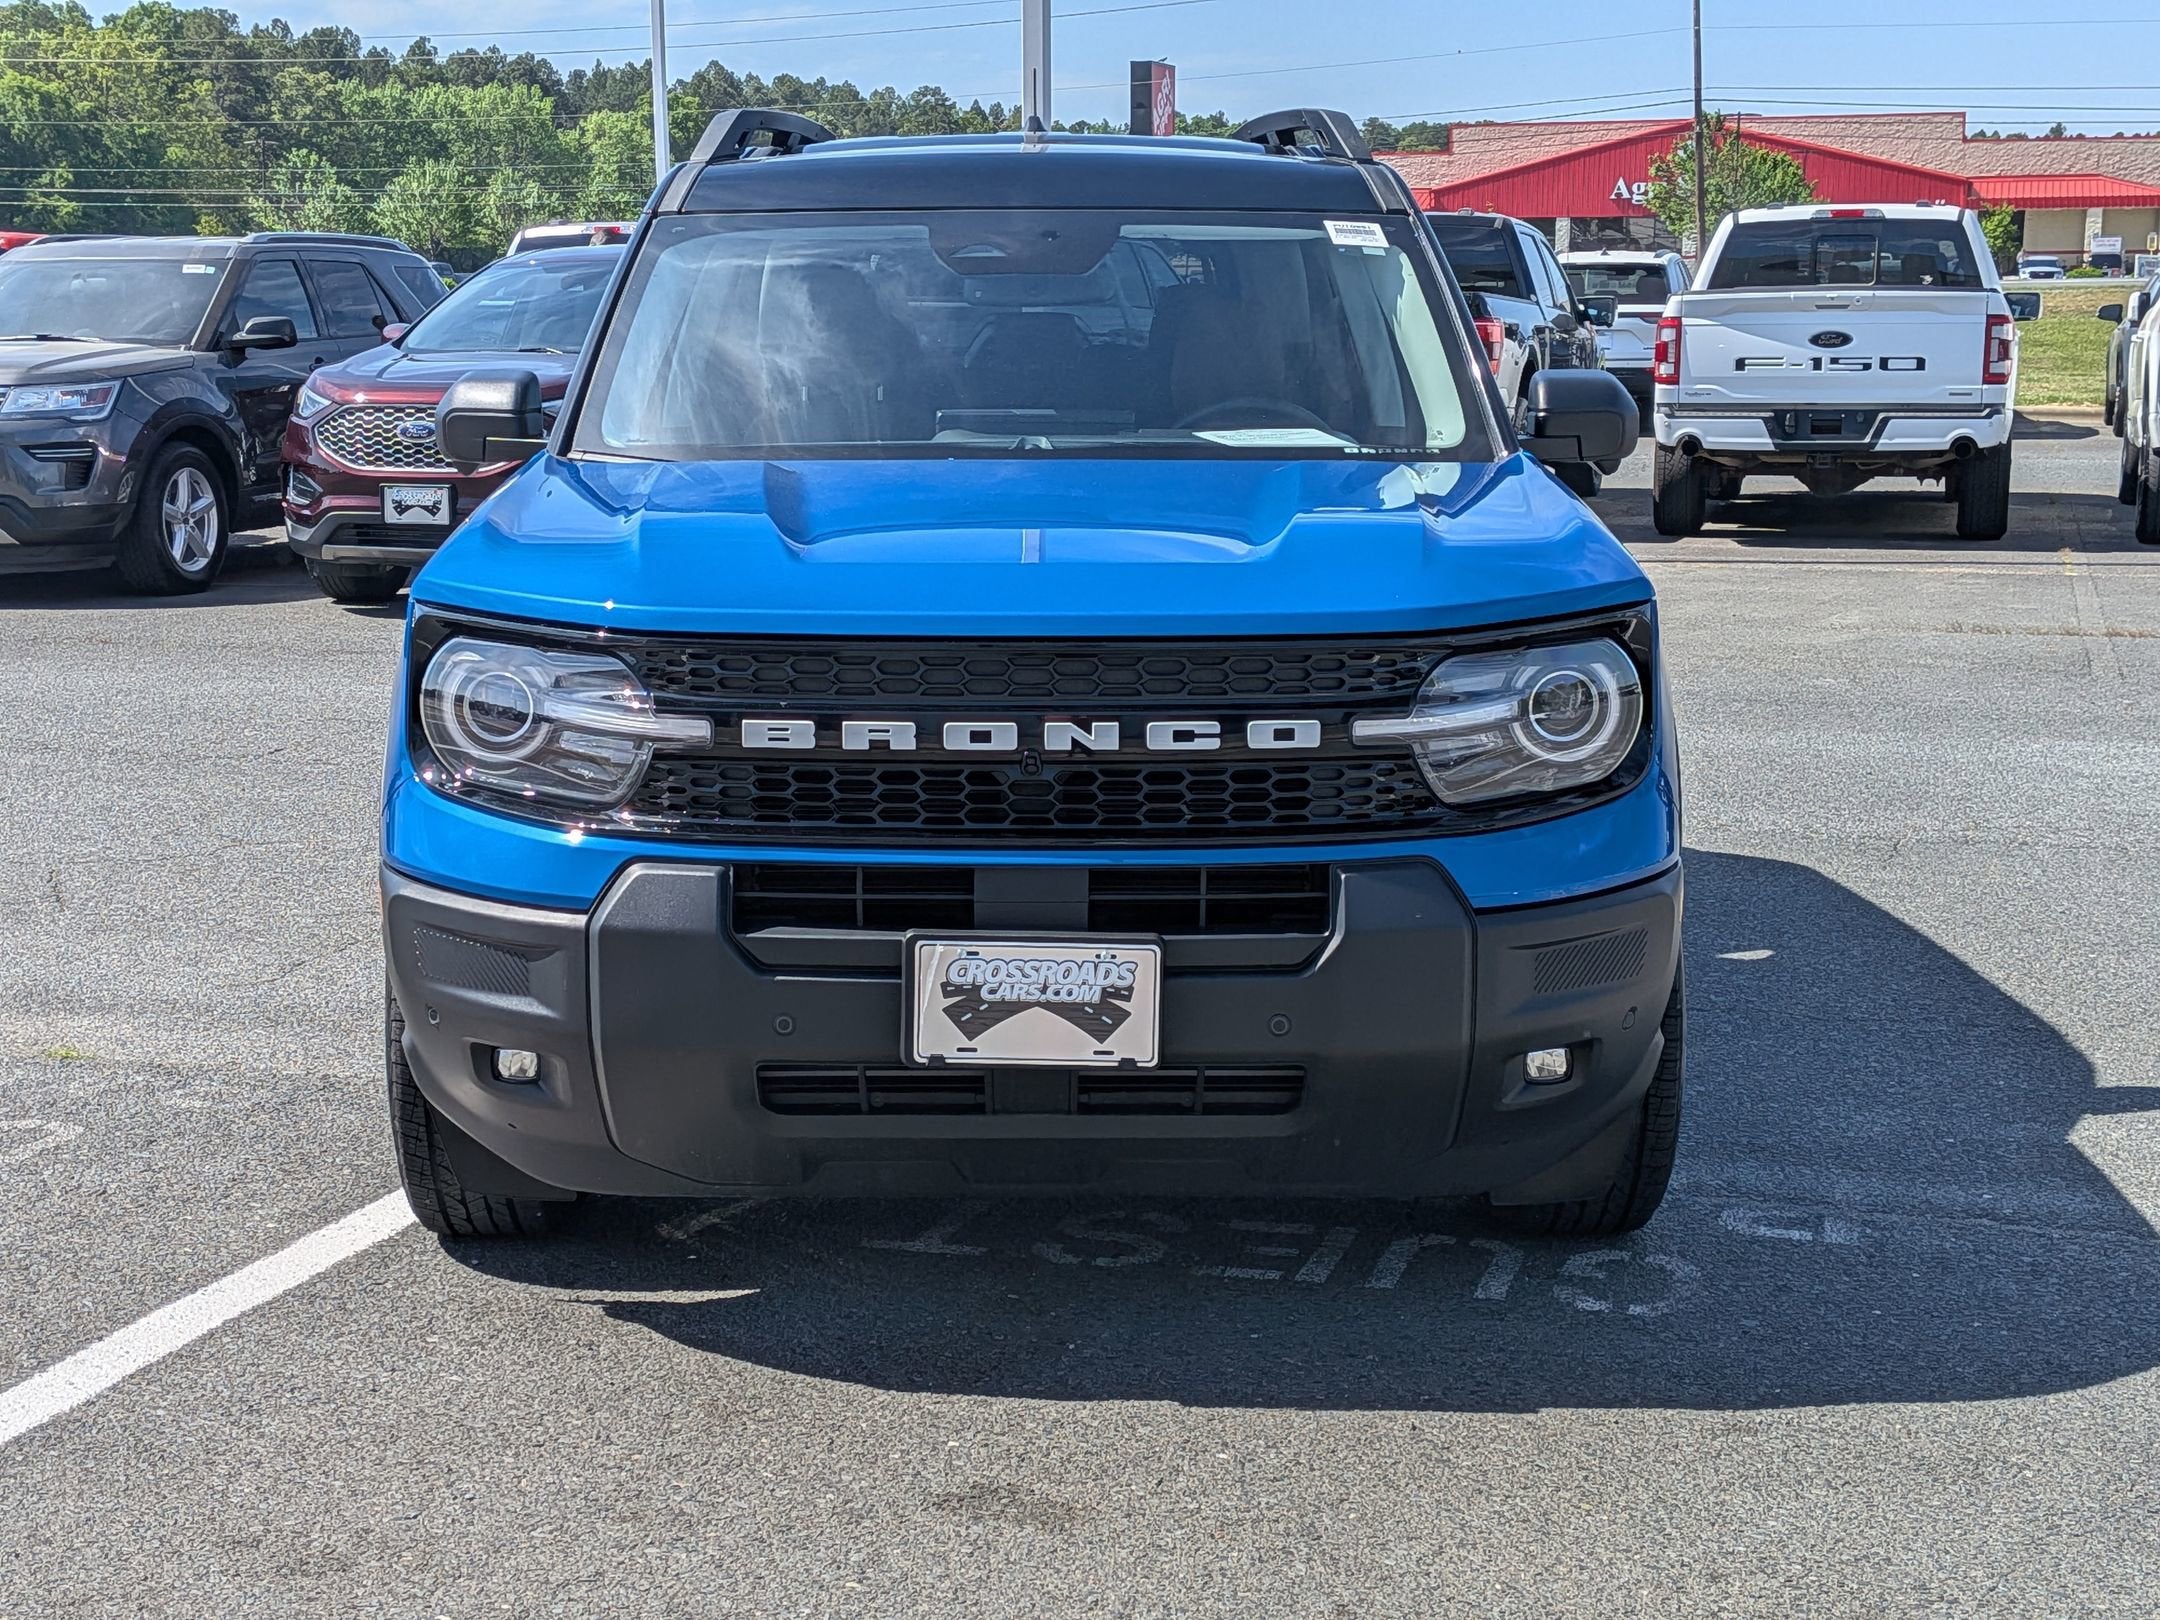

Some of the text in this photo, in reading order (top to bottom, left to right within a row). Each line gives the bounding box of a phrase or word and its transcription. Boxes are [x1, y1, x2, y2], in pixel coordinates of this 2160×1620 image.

[1733, 355, 1927, 373] F-150
[741, 718, 1322, 751] BRONCO
[945, 957, 1138, 988] CROSSROADS
[979, 981, 1104, 1004] CARS.COM
